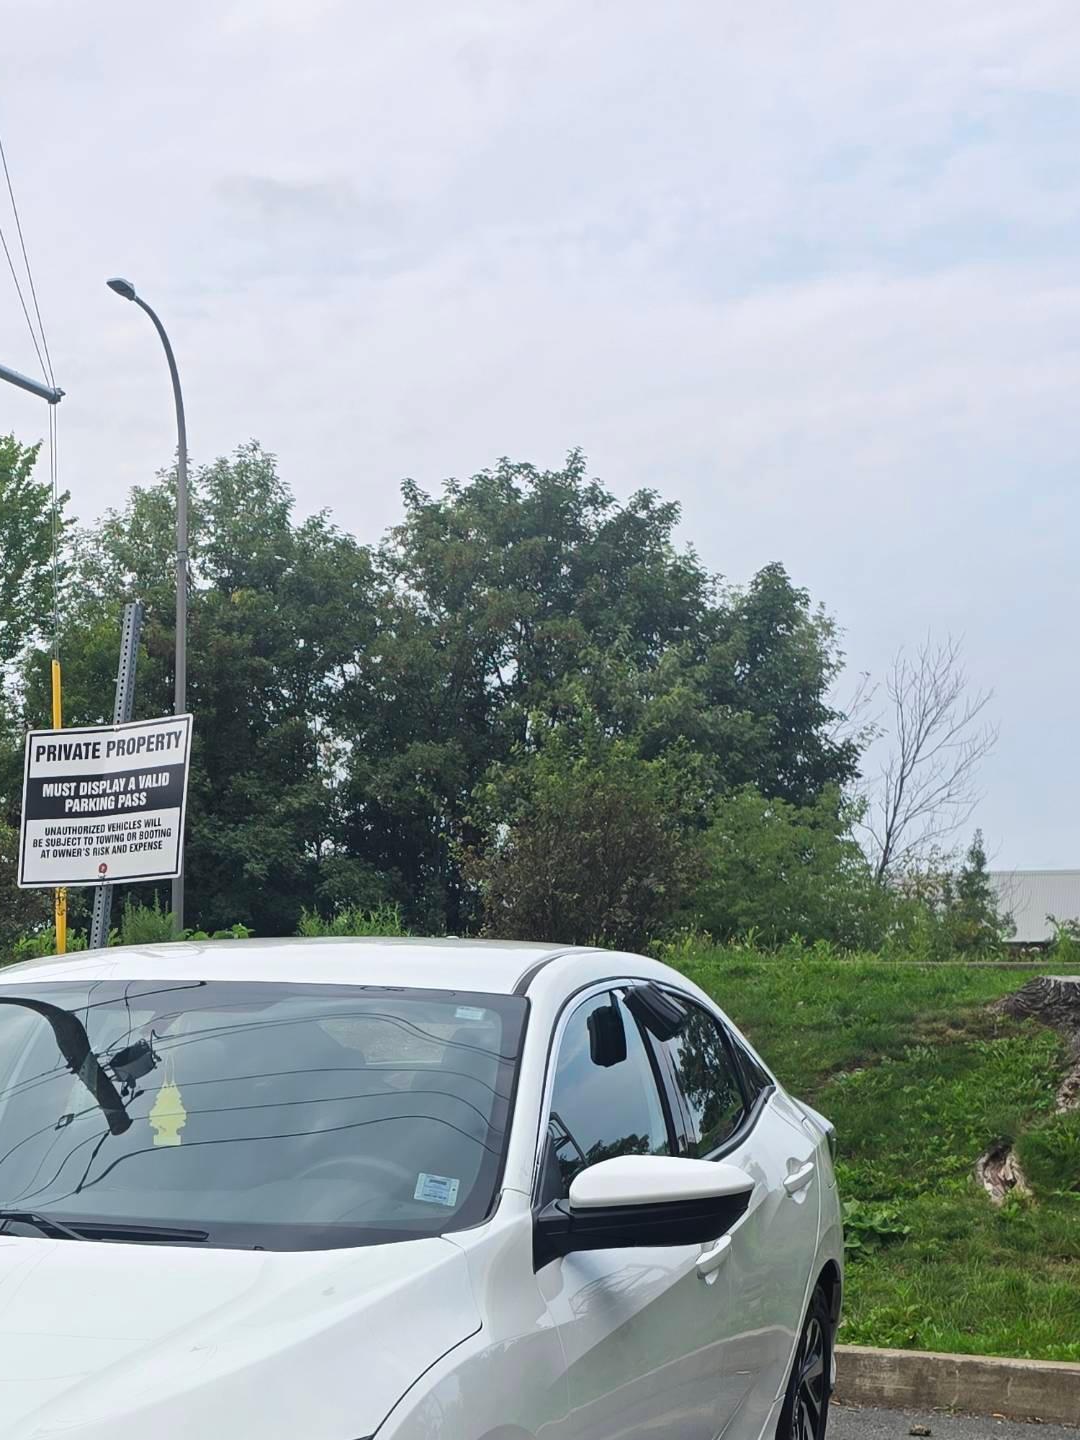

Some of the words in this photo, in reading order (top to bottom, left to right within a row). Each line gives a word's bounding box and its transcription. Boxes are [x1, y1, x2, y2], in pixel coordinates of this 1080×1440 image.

[35, 741, 101, 763] PRIVATE
[106, 730, 182, 758] PROPERTY
[42, 782, 77, 797] MUST
[80, 778, 126, 796] DISPLAY
[128, 776, 136, 791] A
[139, 772, 170, 789] VALID
[65, 795, 115, 812] PARKING
[118, 792, 147, 808] PASS
[45, 824, 105, 836] UNAUTHORIZED
[107, 819, 142, 832] VEHICLES
[144, 817, 161, 828] WILL
[33, 838, 43, 848] BE
[45, 836, 81, 848] SUBJECT
[84, 836, 93, 846] TO
[96, 832, 125, 845] TOWING
[127, 831, 137, 842] OR
[139, 828, 172, 840] BOOTING
[40, 848, 50, 859] AT
[52, 847, 90, 858] OWNER'S
[92, 845, 109, 856] RISK
[112, 843, 127, 854] AND
[129, 840, 163, 852] EXPENSE
